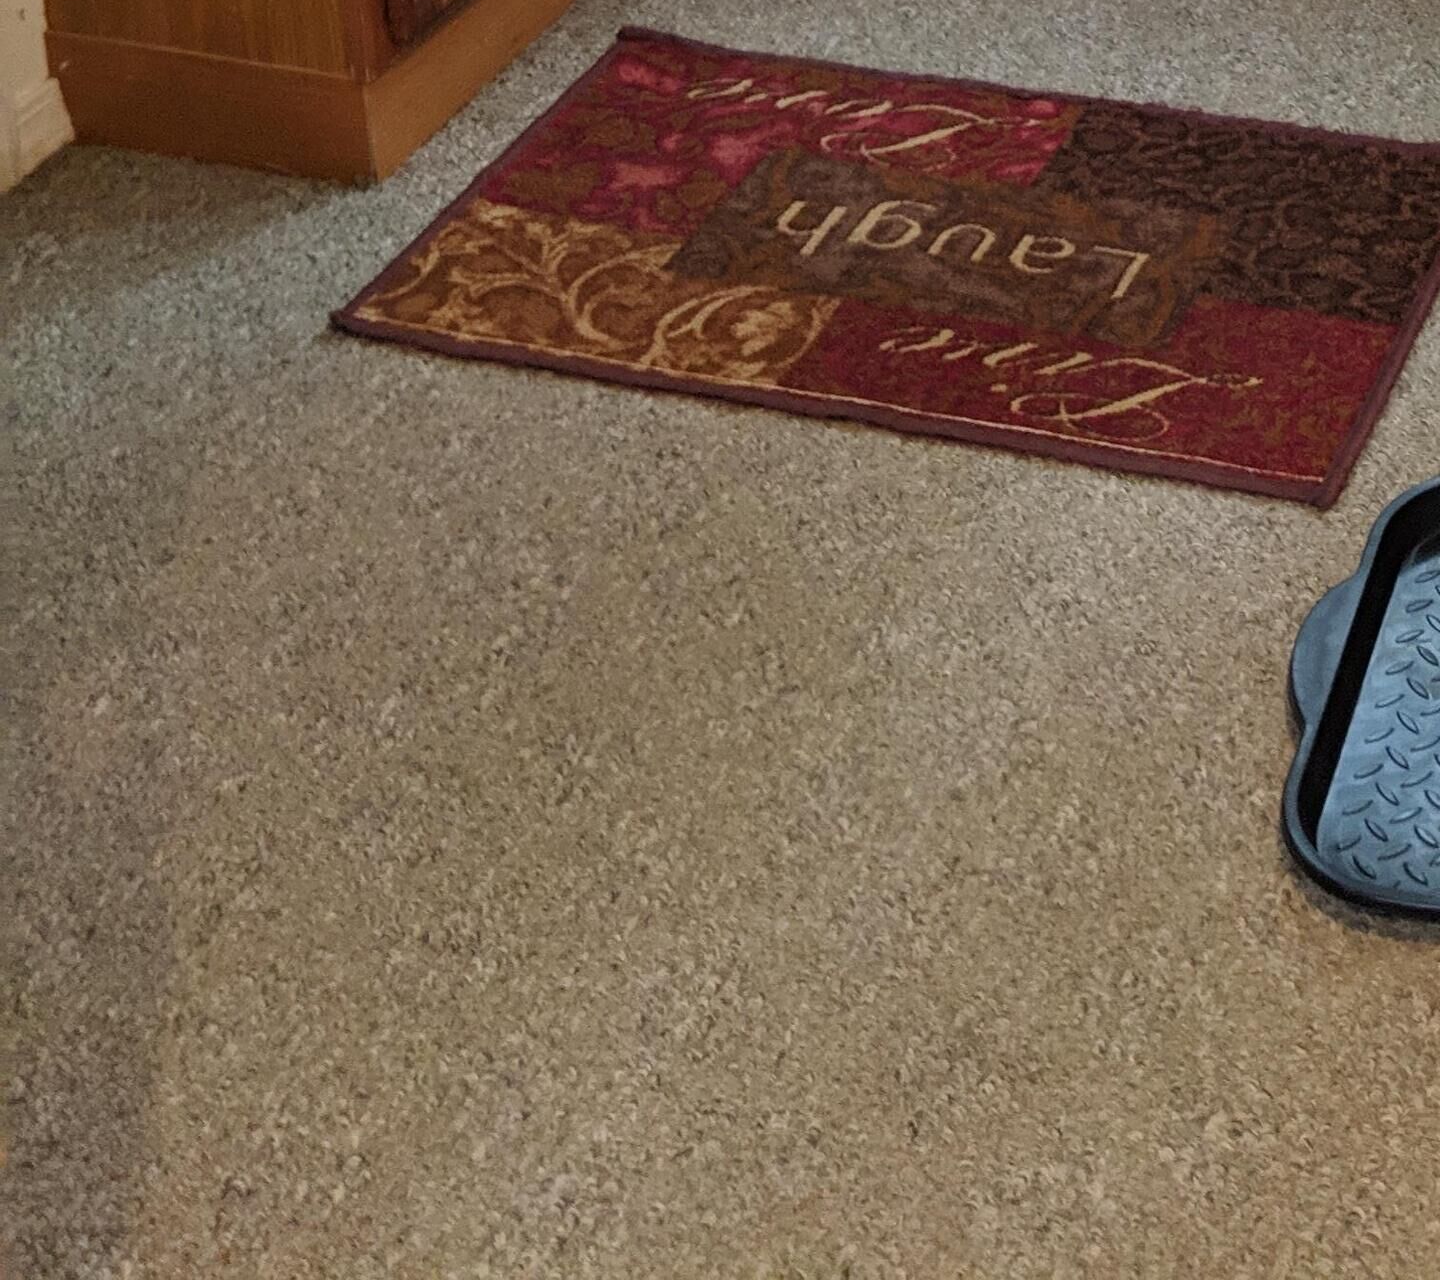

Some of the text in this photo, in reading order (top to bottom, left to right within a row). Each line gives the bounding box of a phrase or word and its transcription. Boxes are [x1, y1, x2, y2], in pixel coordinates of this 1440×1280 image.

[687, 77, 1042, 172] Love
[776, 199, 1150, 300] Laugh
[878, 326, 1263, 441] Live
